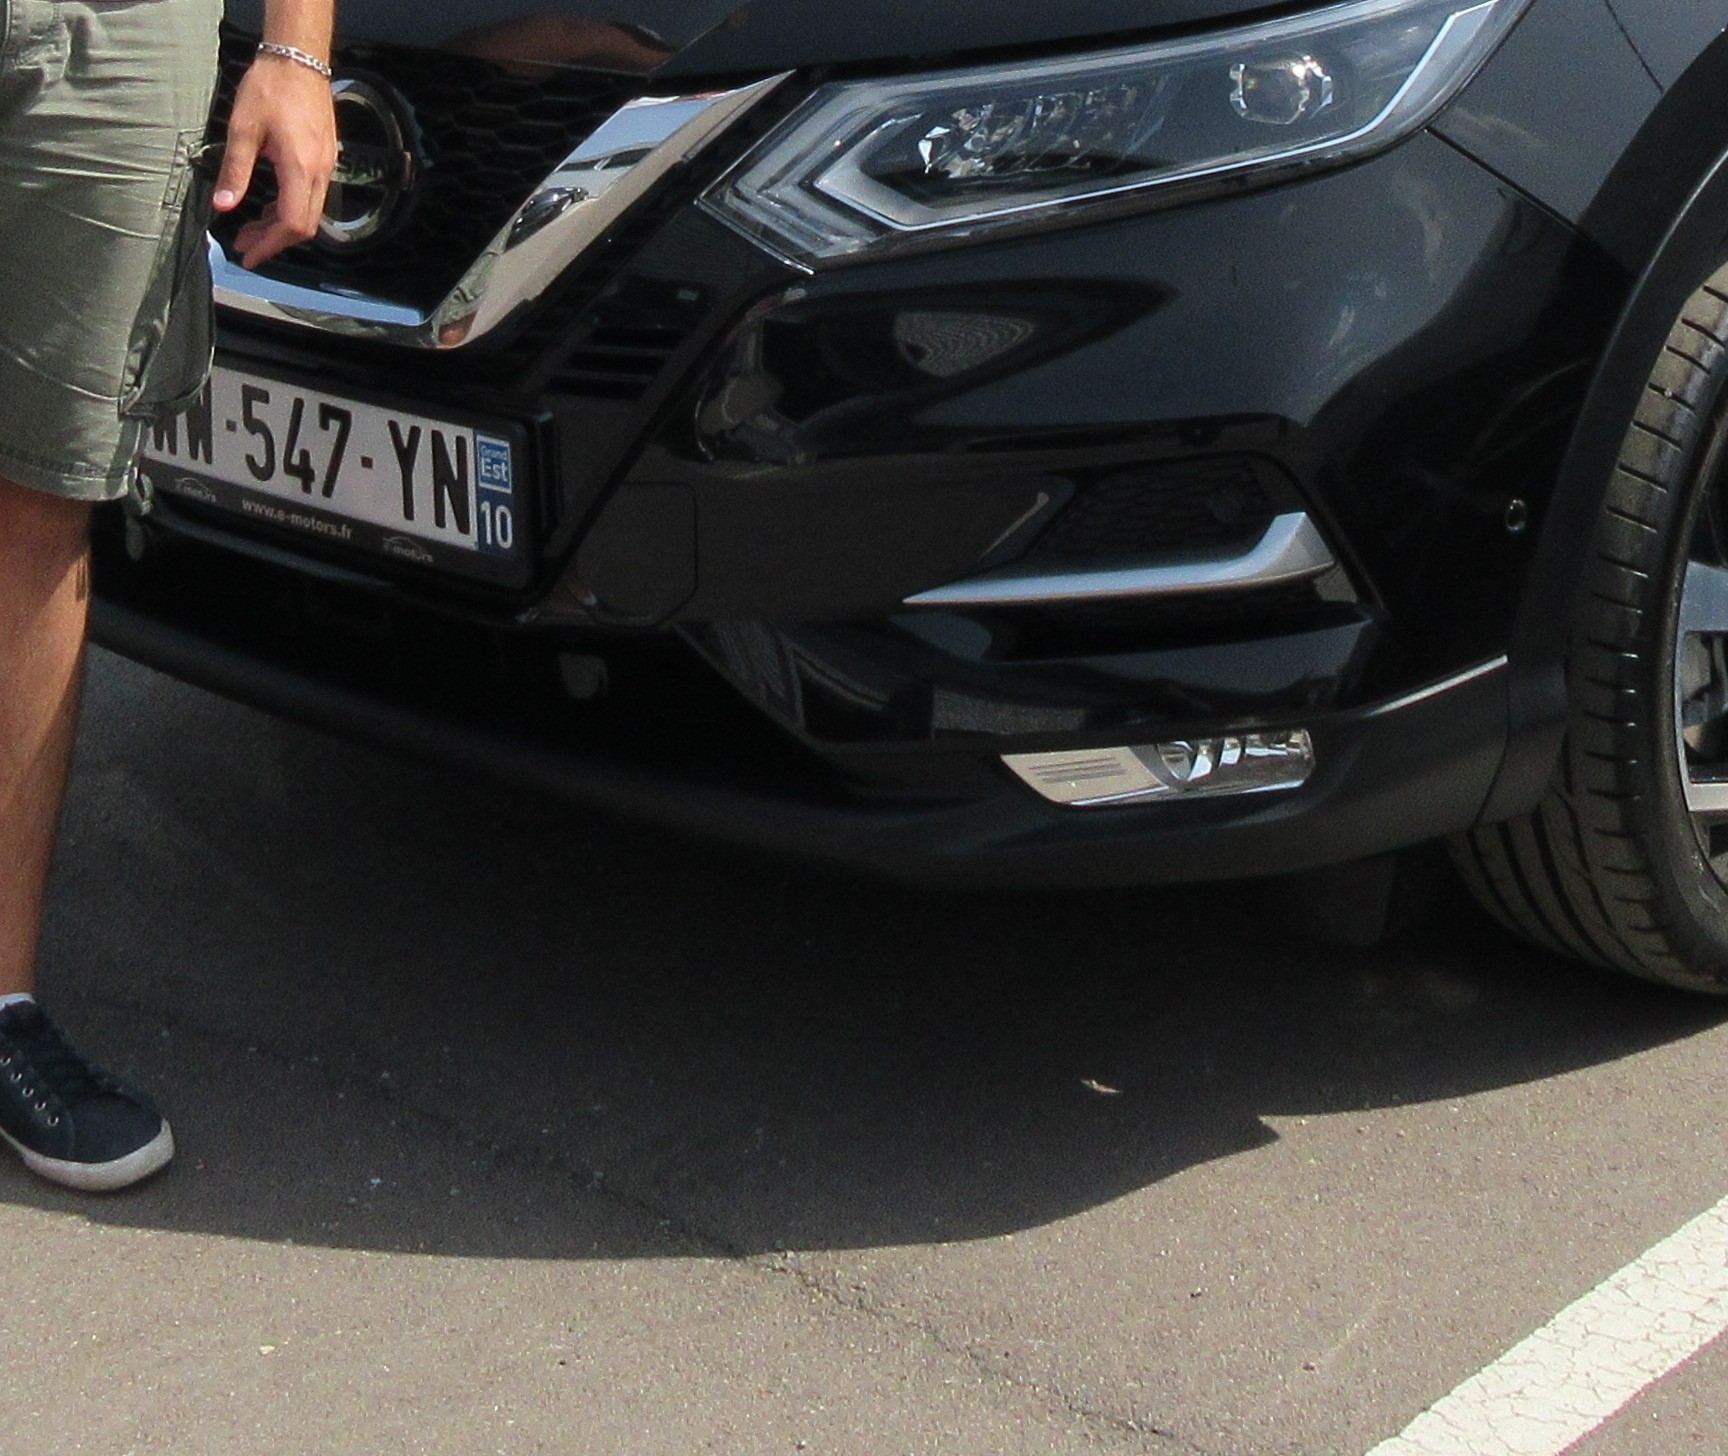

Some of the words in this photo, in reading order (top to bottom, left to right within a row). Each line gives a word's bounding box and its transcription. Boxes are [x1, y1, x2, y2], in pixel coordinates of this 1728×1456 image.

[480, 457, 509, 483] Est
[241, 497, 353, 541] www.e-motors.fr
[480, 499, 513, 550] 10
